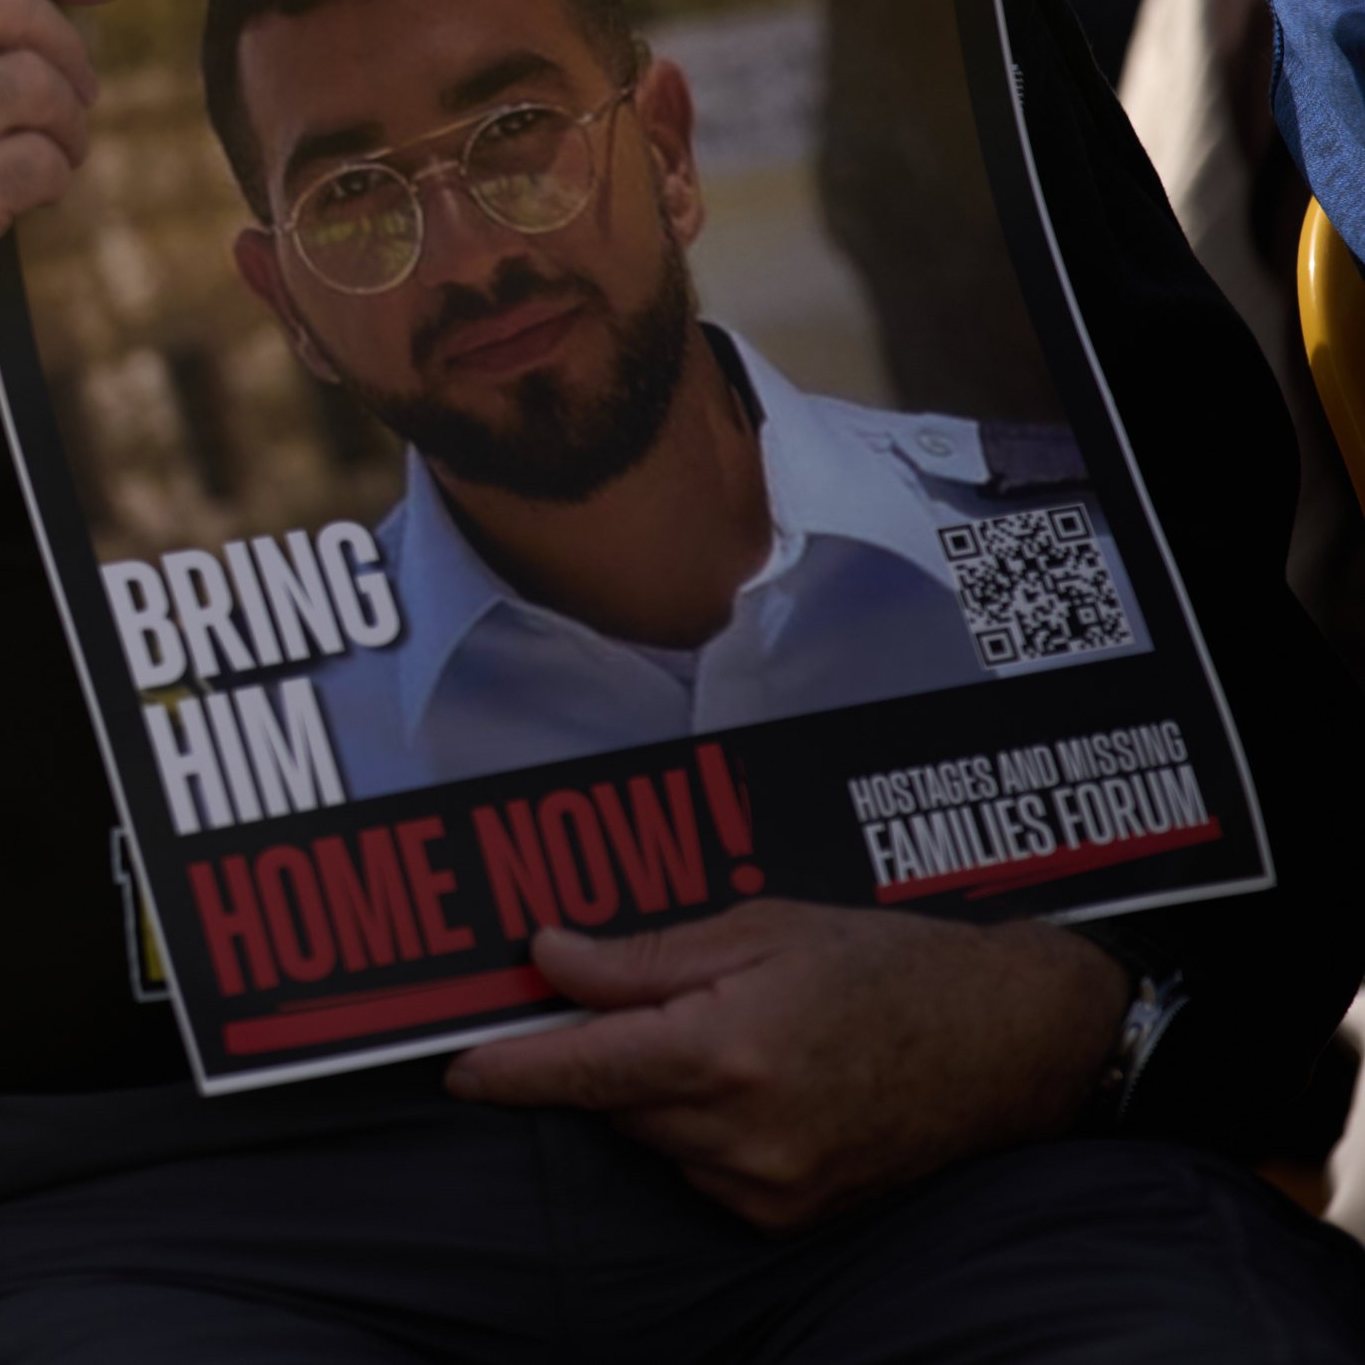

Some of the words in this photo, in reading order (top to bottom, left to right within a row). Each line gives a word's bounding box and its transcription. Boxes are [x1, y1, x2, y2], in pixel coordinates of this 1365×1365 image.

[98, 520, 401, 690] BRING
[142, 676, 347, 836] HIM
[847, 753, 999, 823] HOSTAGES
[997, 742, 1060, 797] AND
[1054, 718, 1188, 784] MISSING
[862, 793, 1058, 888] FAMILIES
[1053, 763, 1210, 851] FORUM
[185, 815, 476, 997] HOME
[472, 741, 765, 942] NOW!
